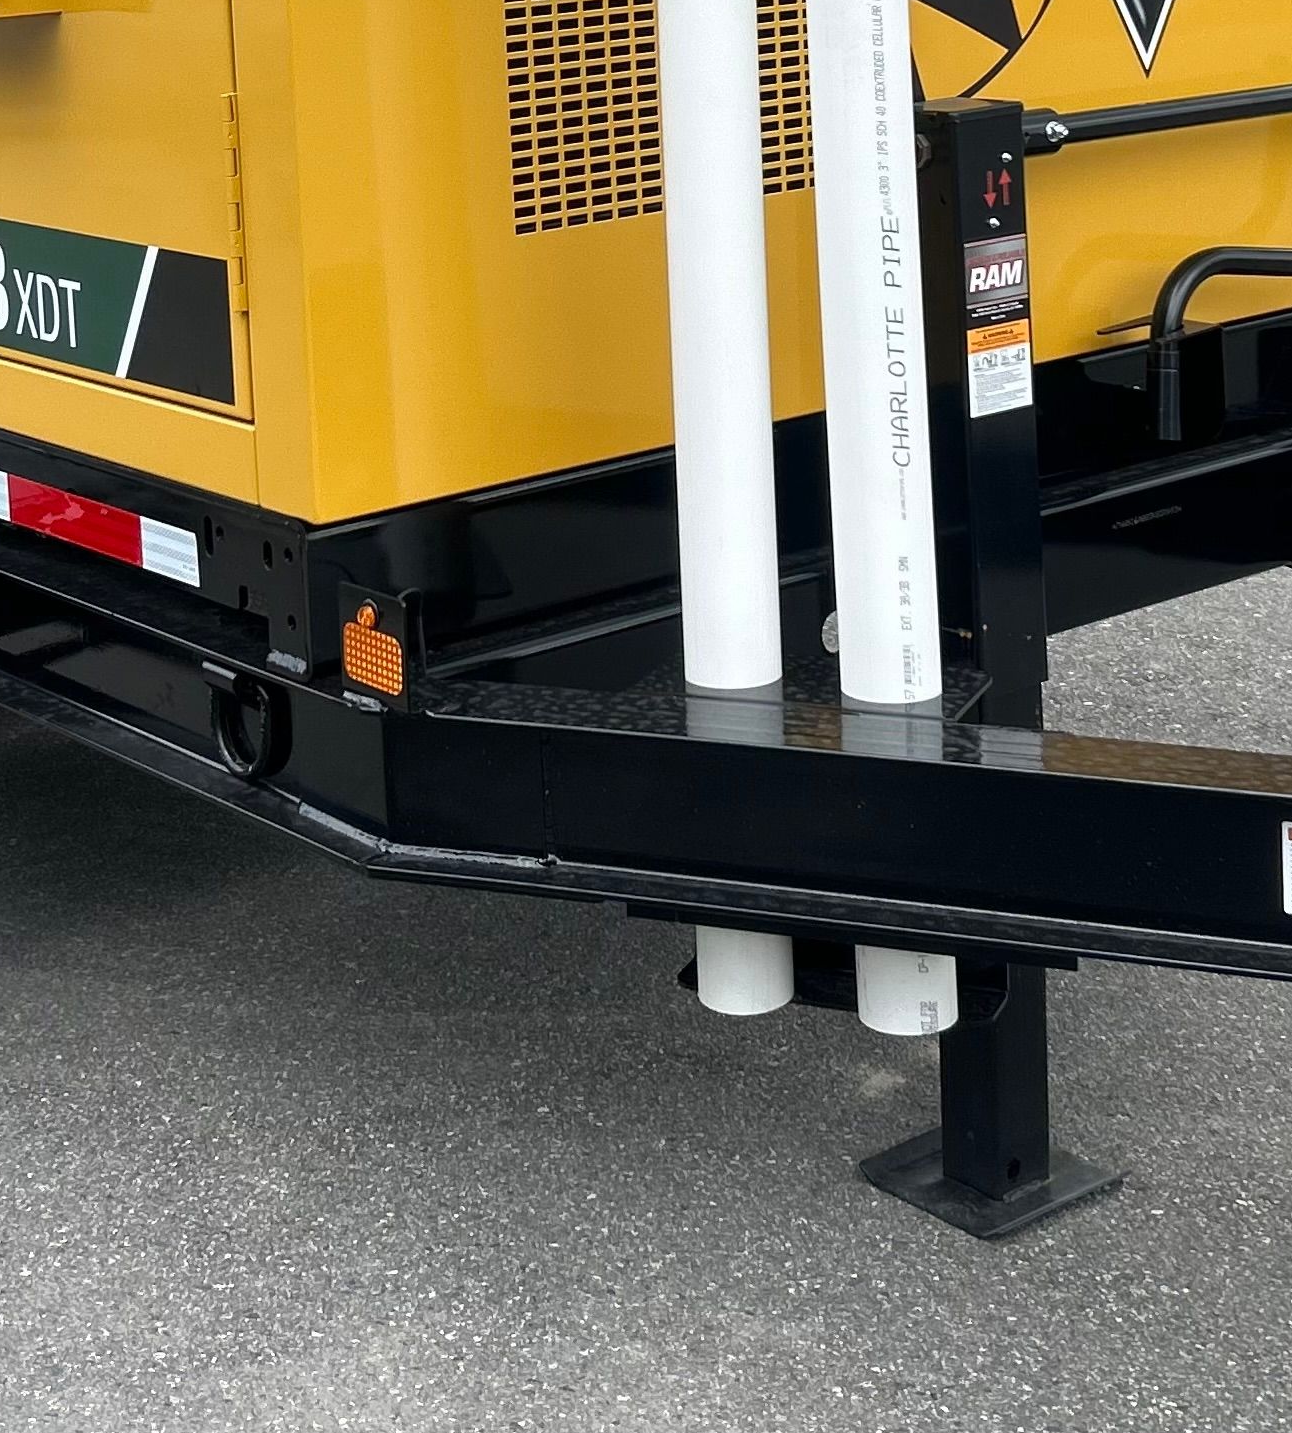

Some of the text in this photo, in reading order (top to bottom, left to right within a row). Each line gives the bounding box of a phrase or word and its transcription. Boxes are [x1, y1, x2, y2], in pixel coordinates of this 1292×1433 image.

[872, 5, 884, 47] CELLULAR
[874, 50, 886, 102] COEXTRUDED
[880, 216, 902, 288] PIPE
[969, 259, 1023, 293] RAM
[13, 268, 81, 348] XDT
[885, 306, 911, 468] CHARLOTTE
